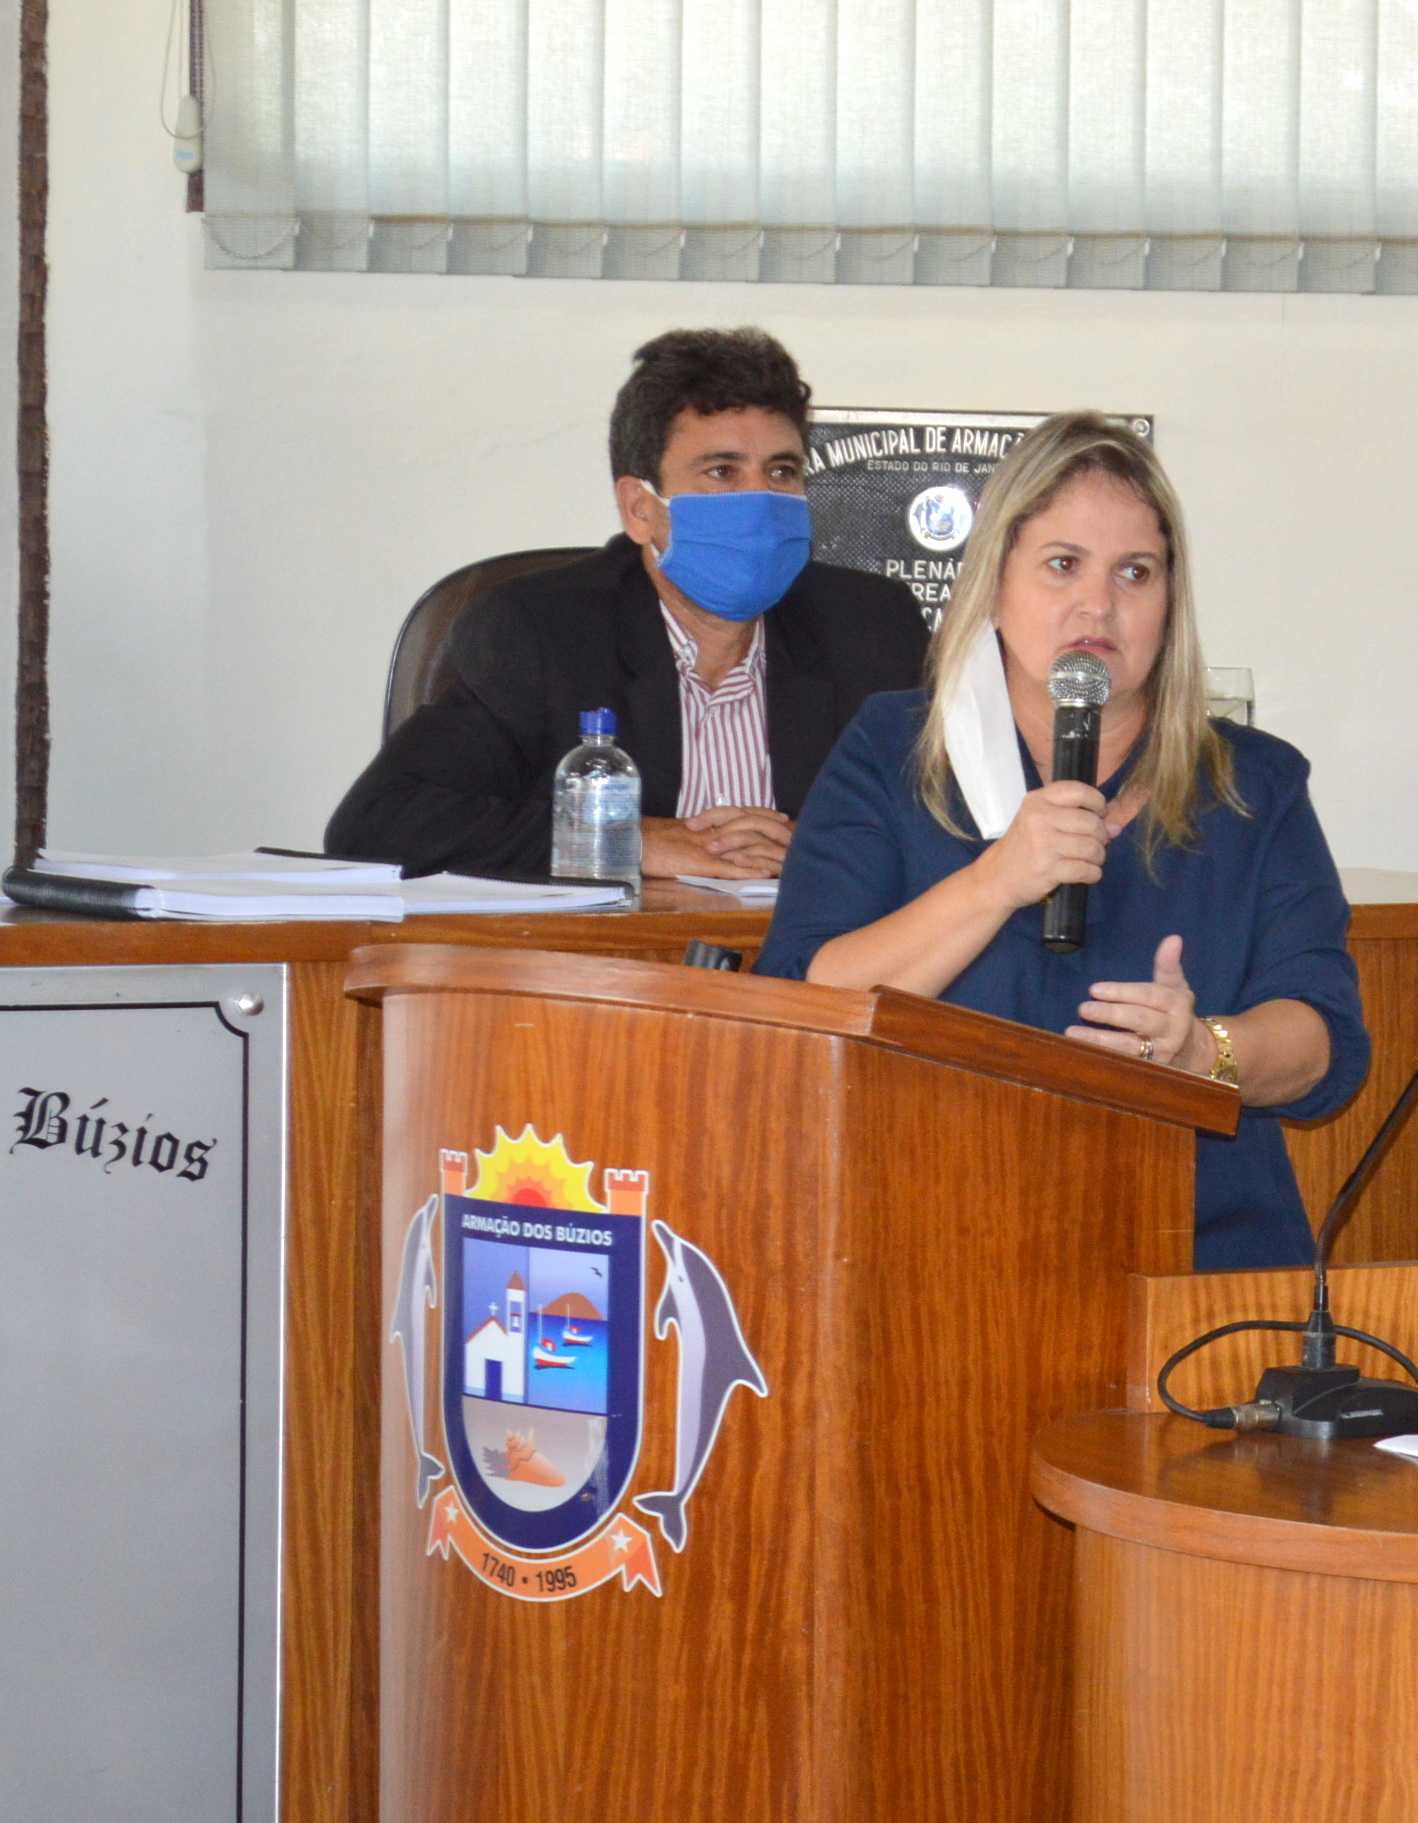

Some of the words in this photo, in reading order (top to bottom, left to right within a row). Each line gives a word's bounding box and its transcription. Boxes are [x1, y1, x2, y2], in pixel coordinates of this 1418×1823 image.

[826, 427, 921, 468] MUNICIPAL
[925, 426, 947, 453] DE
[866, 460, 910, 472] ESTADO
[913, 461, 929, 472] DO
[932, 461, 952, 472] RIO
[955, 462, 970, 473] DE
[974, 463, 998, 474] JAN
[9, 1086, 217, 1182] Búzios
[461, 1213, 520, 1238] ARMAÇÃO
[522, 1222, 552, 1240] DOS
[555, 1222, 613, 1247] BÚZIOS
[482, 1552, 516, 1588] 1740
[535, 1564, 577, 1593] 1995
